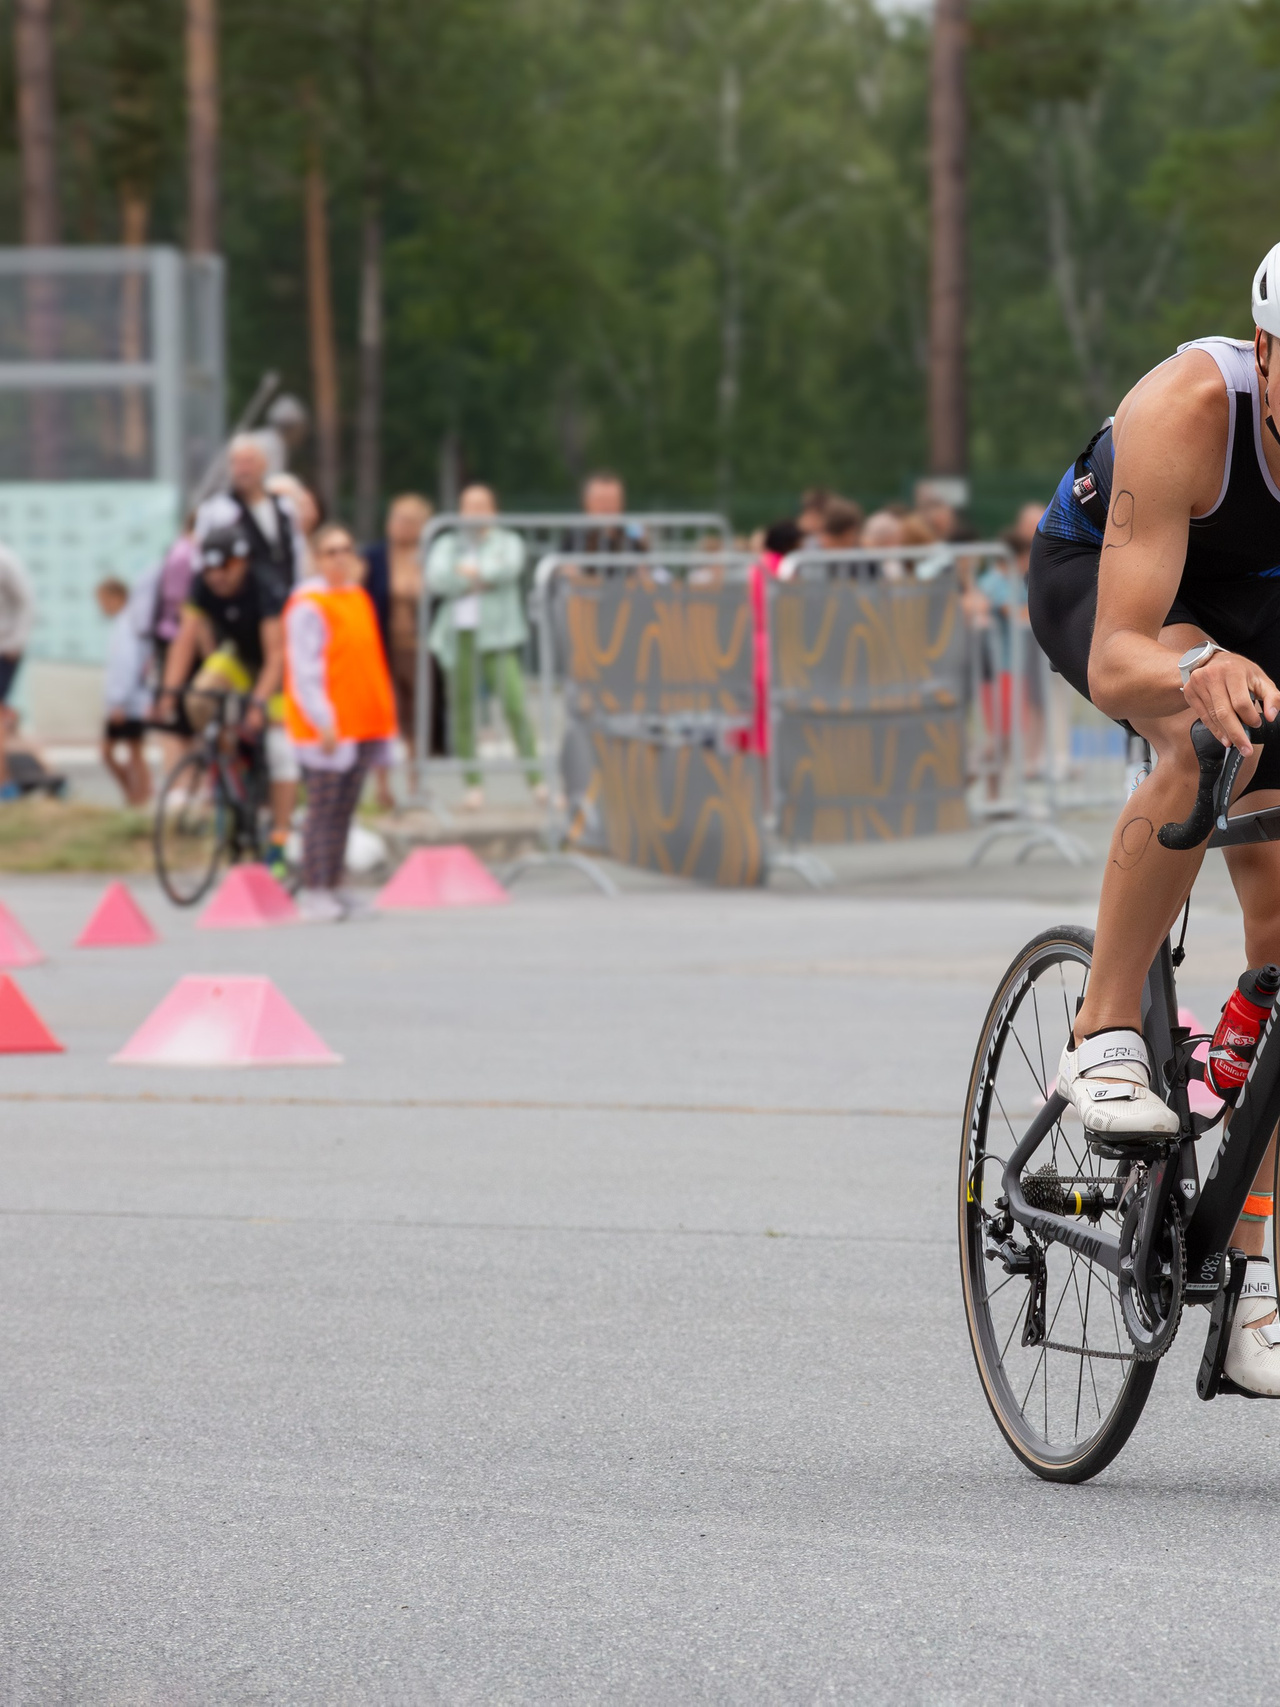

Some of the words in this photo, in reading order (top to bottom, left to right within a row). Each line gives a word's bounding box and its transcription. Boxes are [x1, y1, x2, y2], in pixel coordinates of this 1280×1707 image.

[1104, 490, 1135, 550] 9
[1113, 816, 1154, 870] 9
[1219, 1060, 1248, 1078] Emirate
[1031, 1214, 1102, 1261] CIPOLLINI
[1200, 1251, 1224, 1281] 4380
